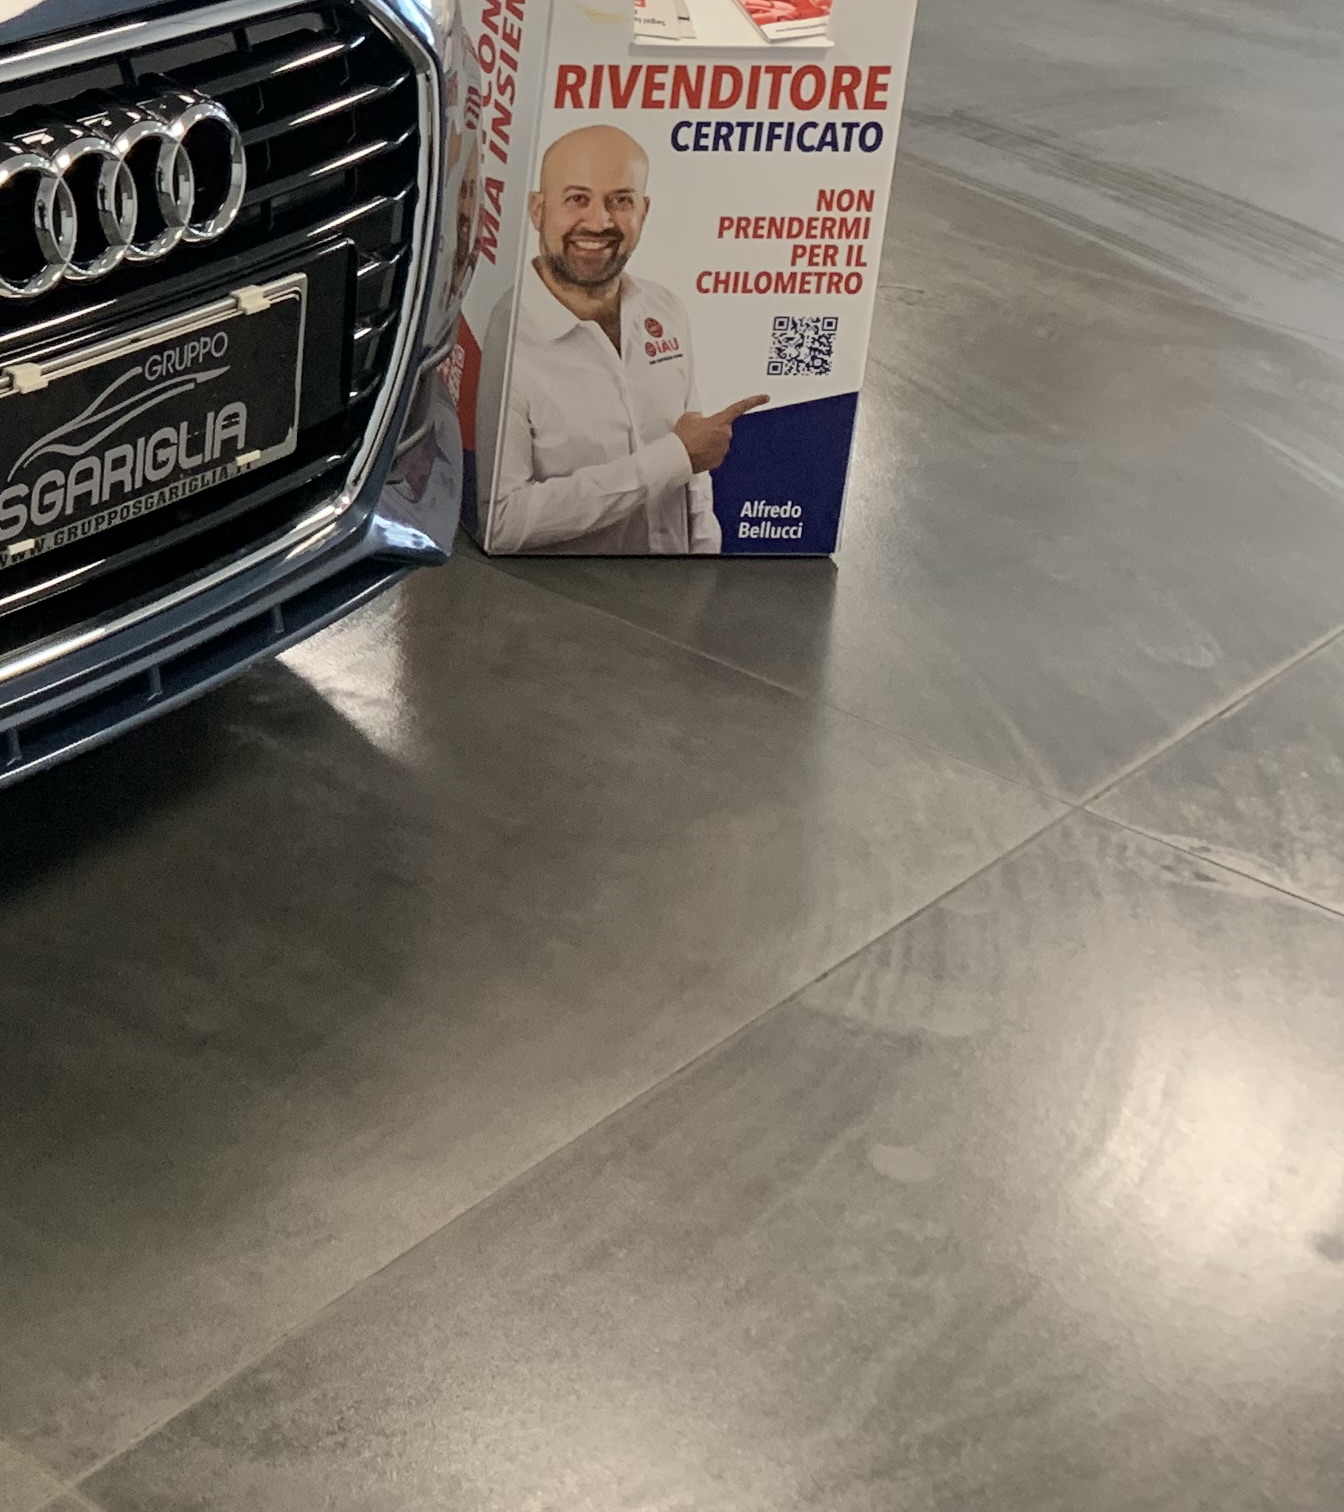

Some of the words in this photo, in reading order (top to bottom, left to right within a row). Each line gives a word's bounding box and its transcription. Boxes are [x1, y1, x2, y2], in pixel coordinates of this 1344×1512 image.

[553, 63, 893, 111] RIVENDITORE
[670, 120, 884, 154] CERTIFICATO
[815, 189, 876, 213] NON
[480, 176, 505, 265] MA
[716, 216, 871, 240] PRENDERMI
[790, 244, 840, 267] PER
[845, 245, 868, 268] IL
[696, 270, 864, 295] CHILOMETRO
[144, 331, 228, 381] GRUPPO
[740, 500, 802, 518] Alfredo
[738, 521, 803, 539] Bellucci
